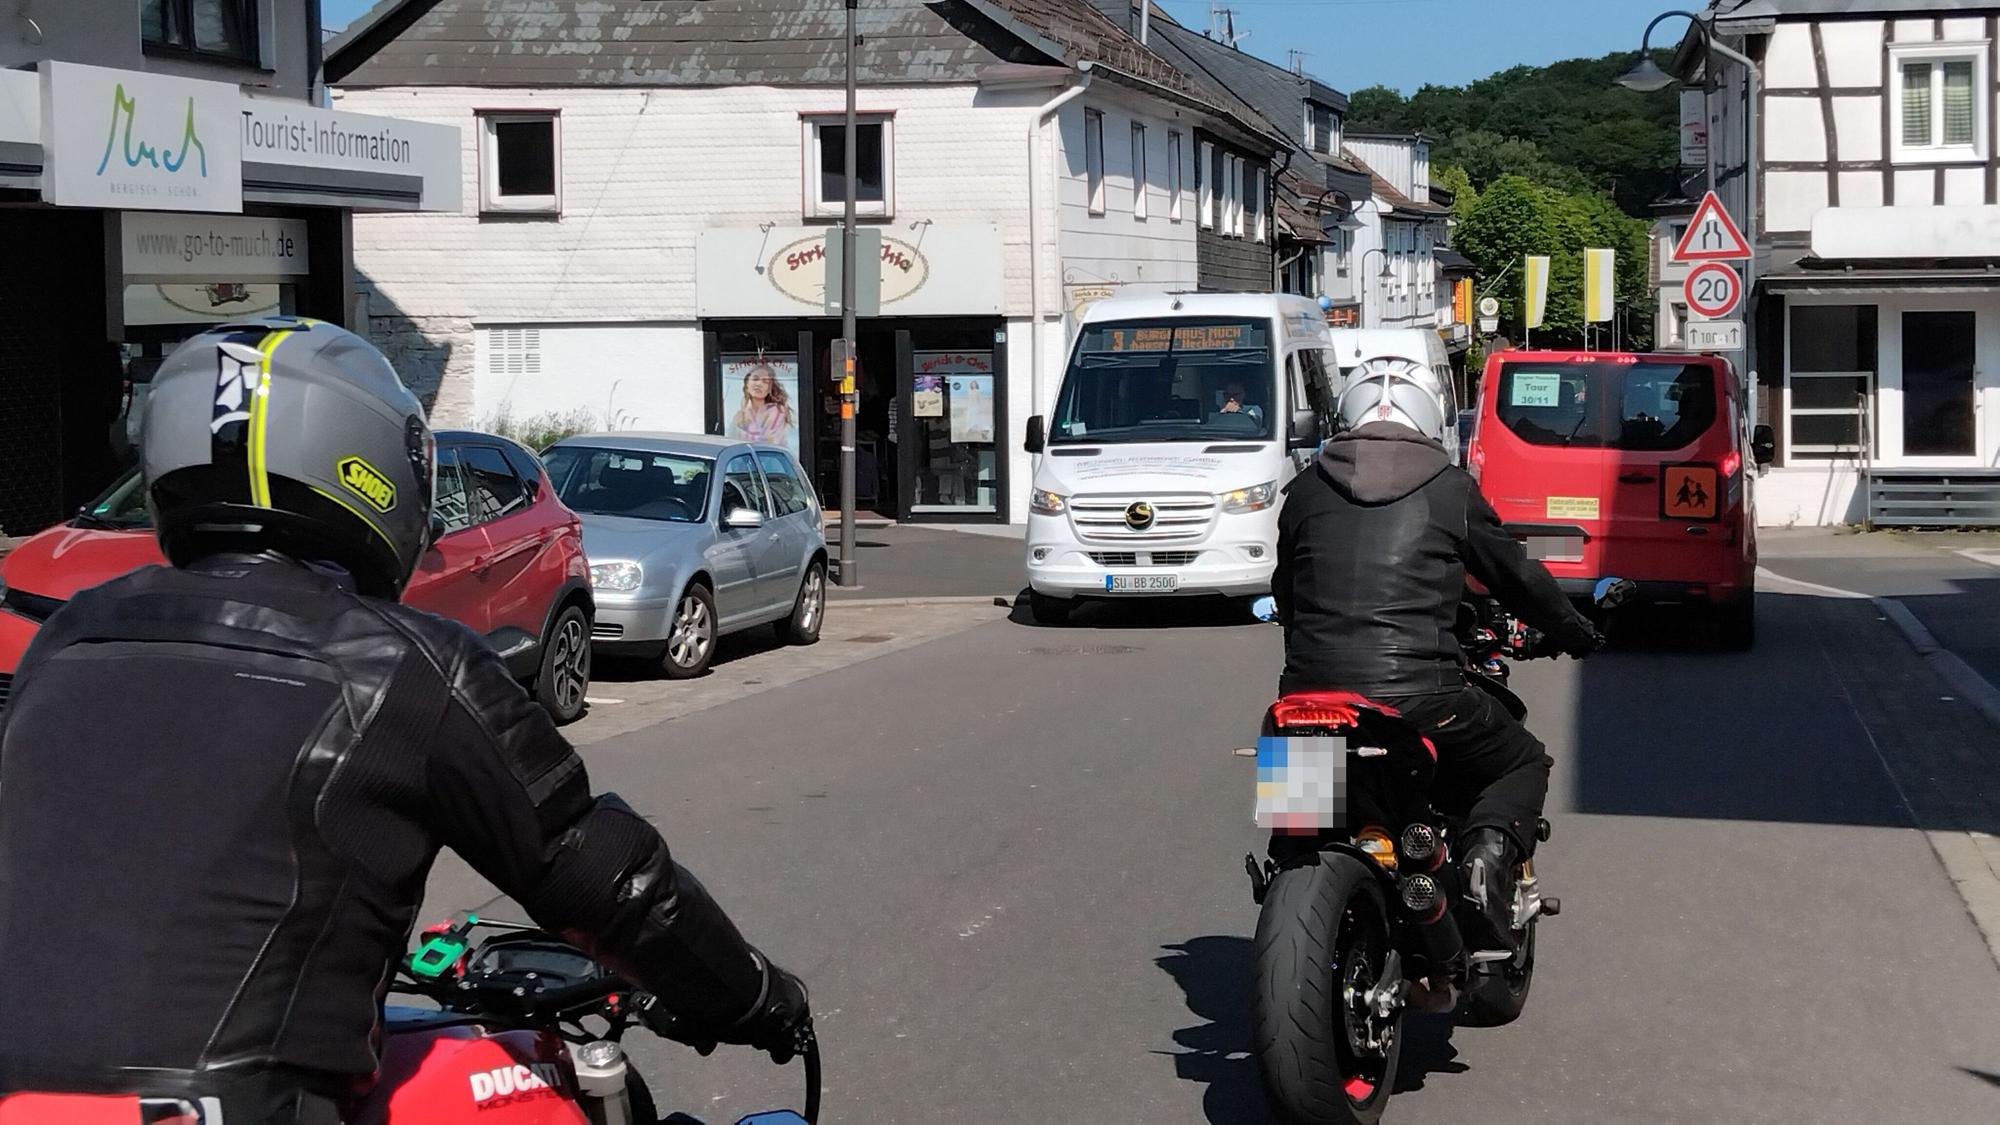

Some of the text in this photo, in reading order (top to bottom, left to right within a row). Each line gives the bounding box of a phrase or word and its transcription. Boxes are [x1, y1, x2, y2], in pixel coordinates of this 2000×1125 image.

[96, 83, 207, 178] Much
[241, 111, 410, 164] Tourist-Information
[136, 229, 294, 263] www.go-to-much.de
[1697, 278, 1729, 302] 20
[1208, 327, 1240, 338] MUCH
[1525, 383, 1548, 391] Tour
[345, 462, 394, 508] SHOEI
[1114, 577, 1175, 588] SU BB 2500
[469, 1063, 561, 1102] DUCATI
